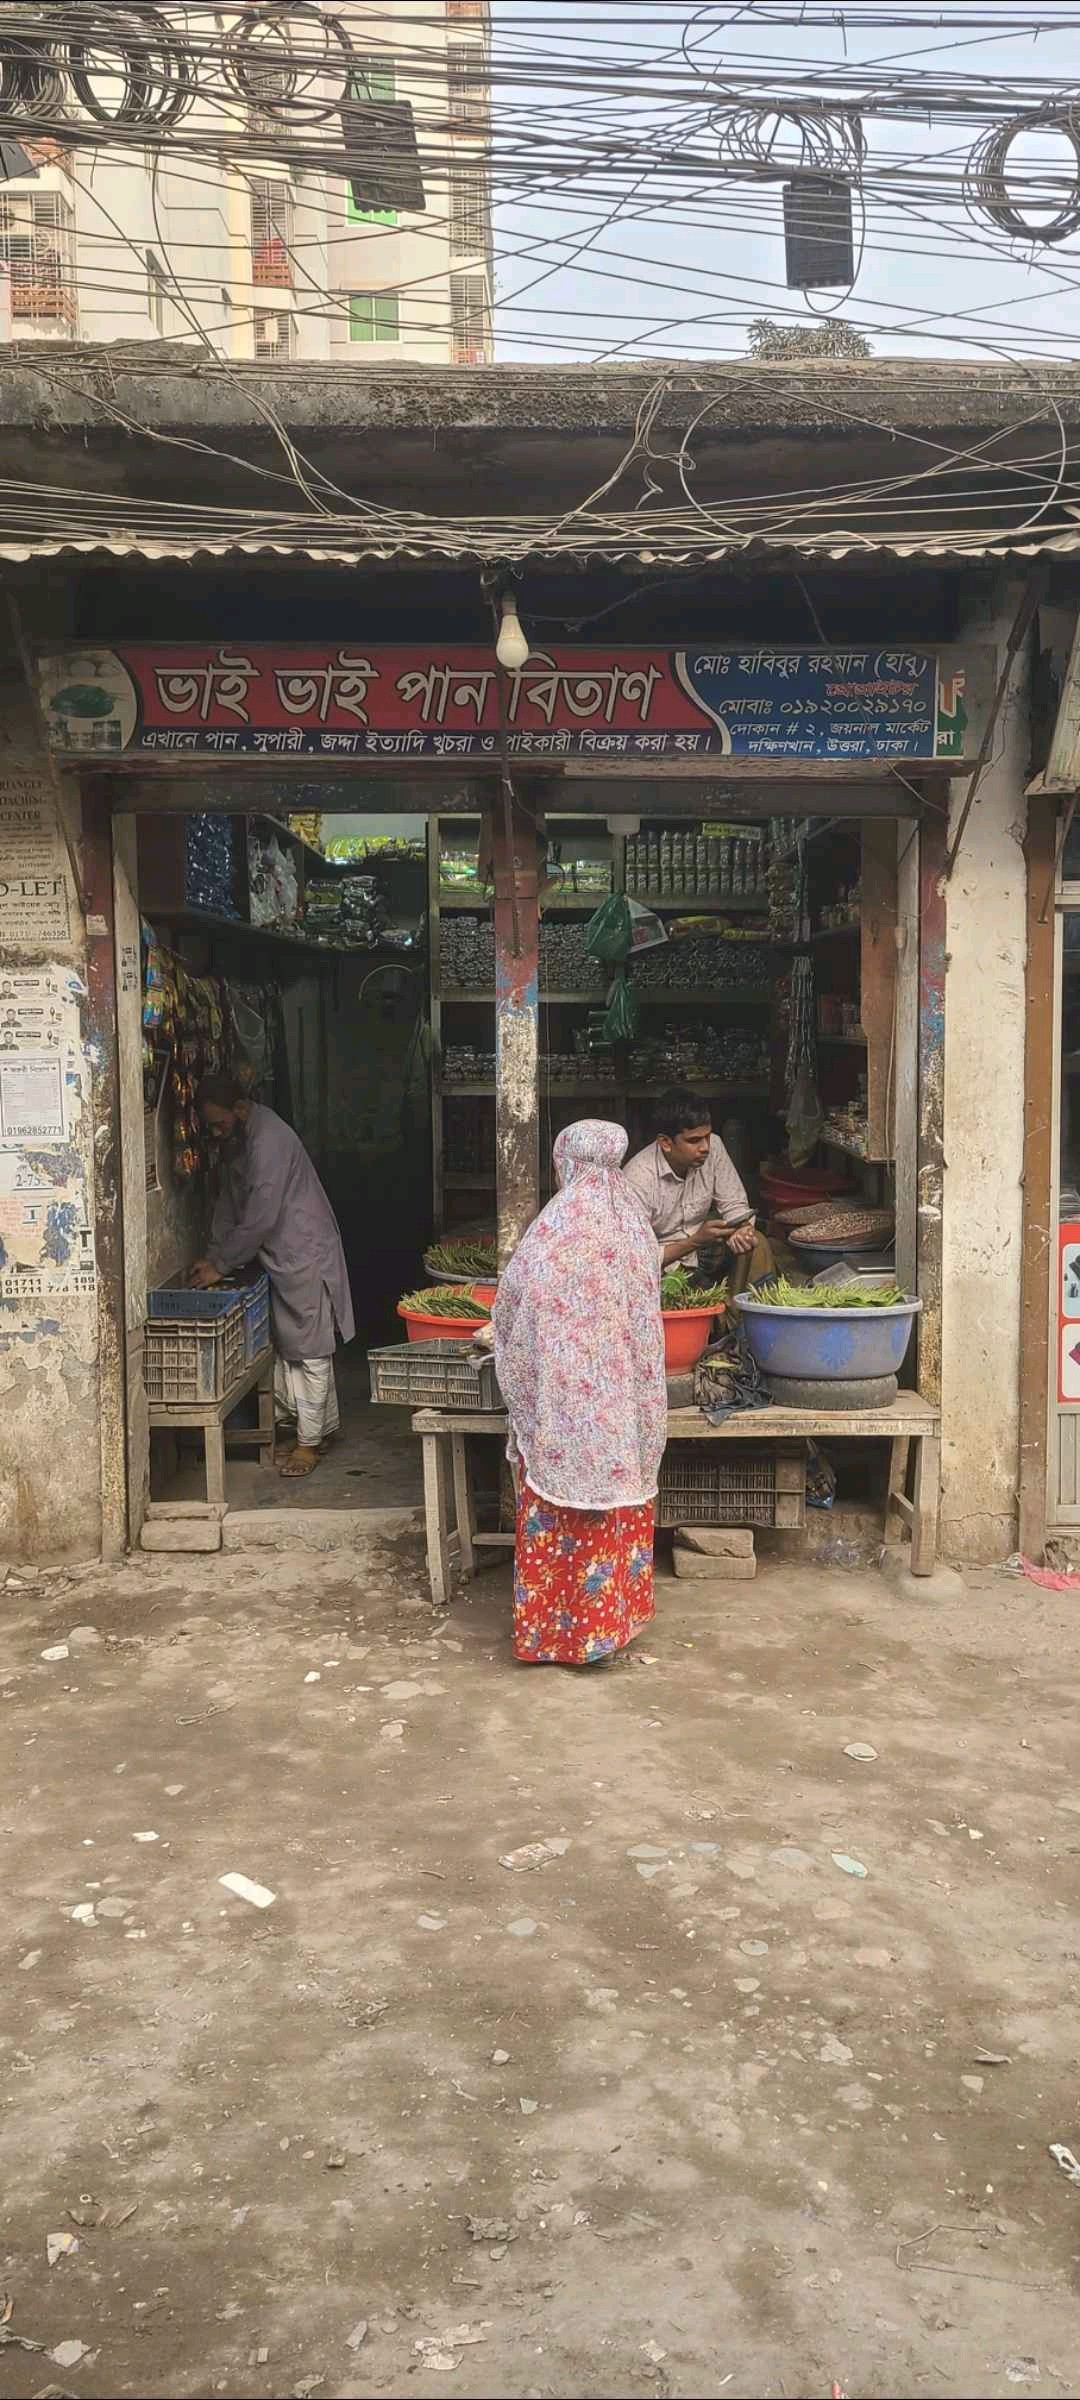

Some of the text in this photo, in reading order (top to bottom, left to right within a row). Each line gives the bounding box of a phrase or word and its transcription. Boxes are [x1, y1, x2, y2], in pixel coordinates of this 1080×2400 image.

[694, 648, 927, 679] মোঃ হাবিবুর রহমান (হাবু)
[153, 649, 663, 725] ভাই ভাই পান বিতাণ
[719, 699, 927, 715] মোবাঃ ০১৯২০০২৯১৭০
[730, 722, 781, 735] দোকান
[885, 718, 931, 735] মার্কেট
[142, 730, 200, 749] এখানে
[365, 729, 427, 752] ইত্যাদি
[433, 733, 475, 755] খুচরা
[481, 736, 496, 750] ও
[505, 728, 573, 751] পাইকারী
[579, 729, 630, 751] বিক্রয়
[634, 733, 668, 751] করা
